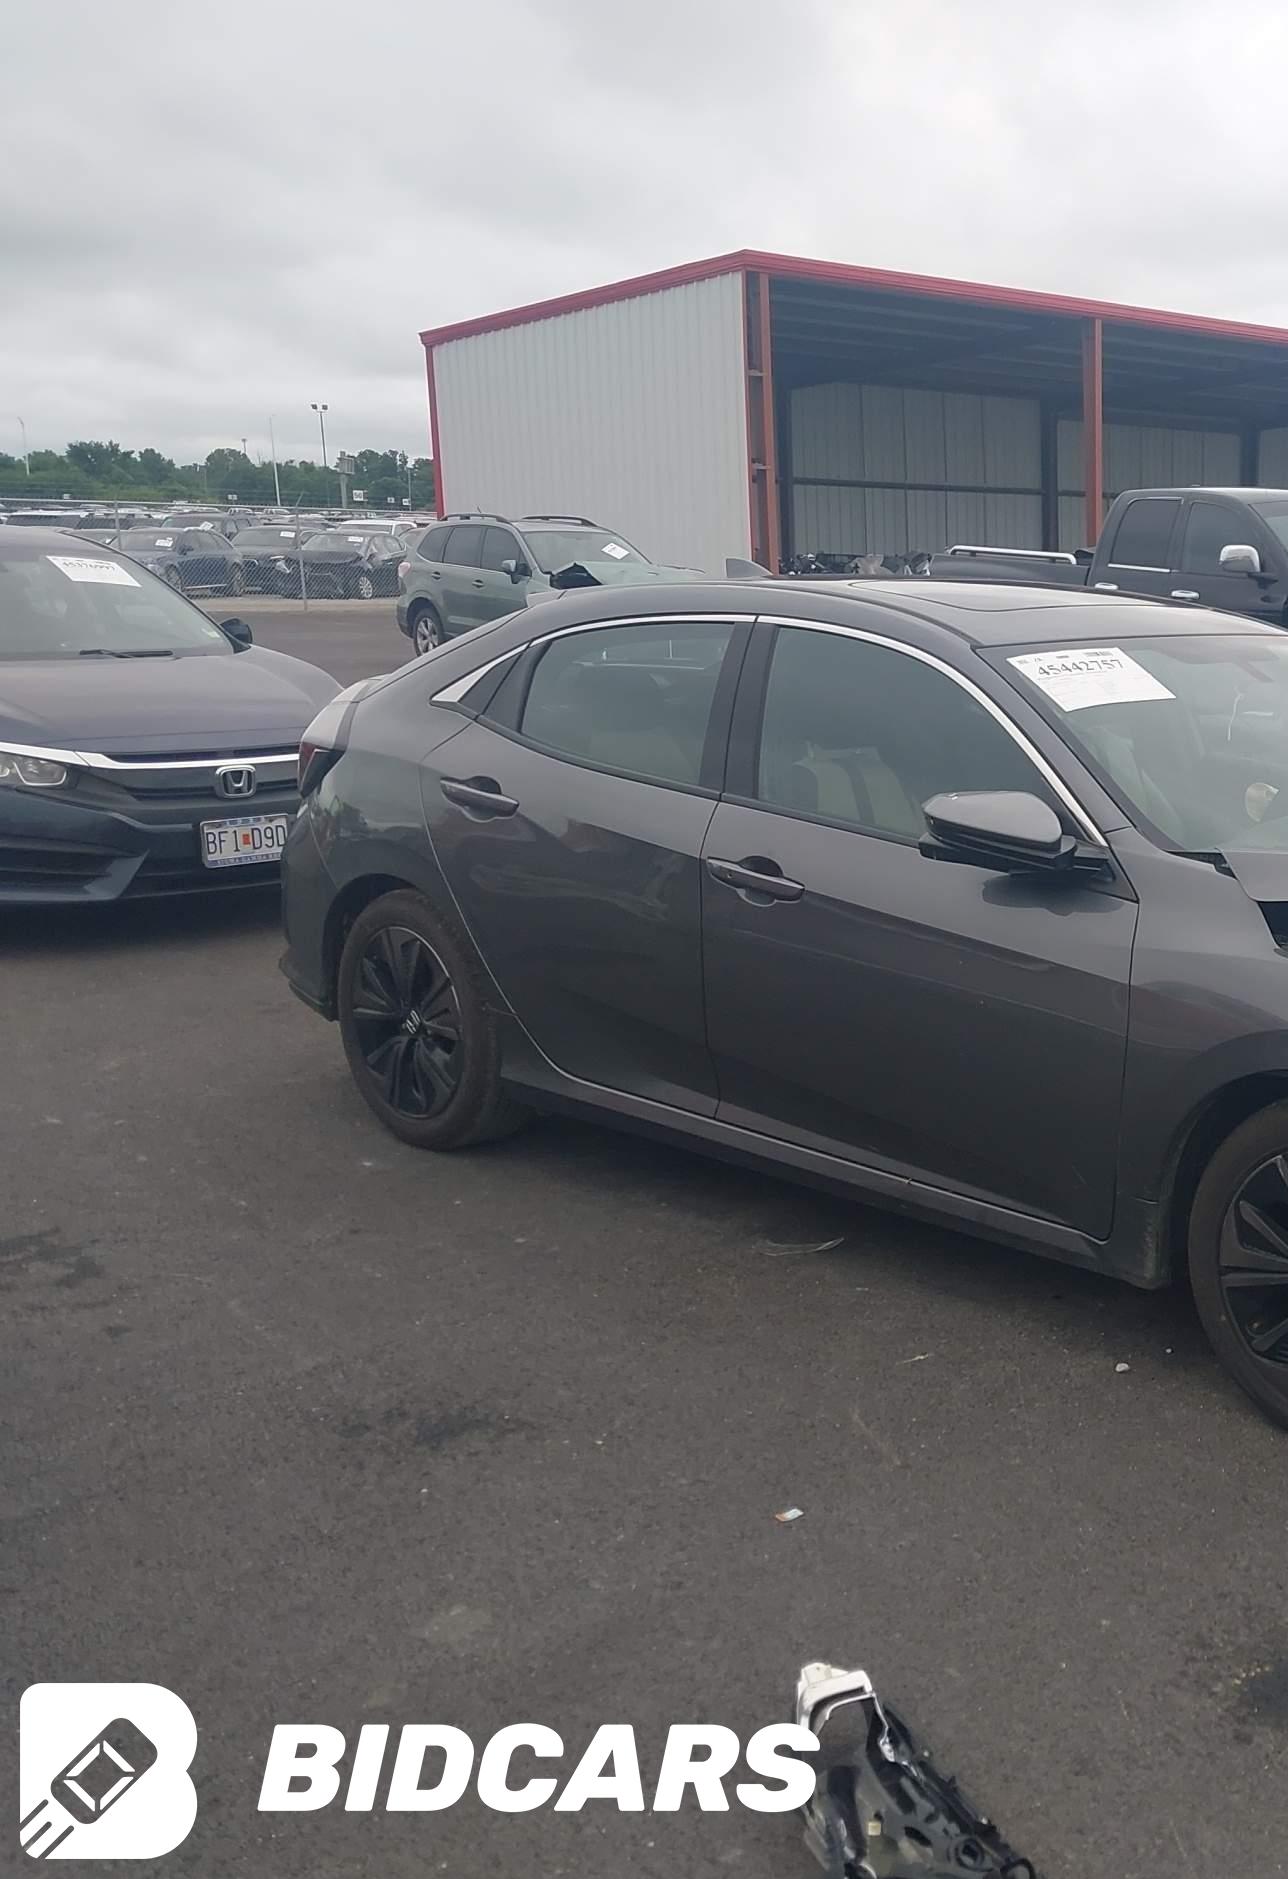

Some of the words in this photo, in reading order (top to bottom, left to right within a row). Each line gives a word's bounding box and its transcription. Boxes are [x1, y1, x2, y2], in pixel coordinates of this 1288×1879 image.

[1037, 659, 1124, 676] 45442757
[205, 829, 241, 855] BF1
[251, 824, 287, 850] D9D
